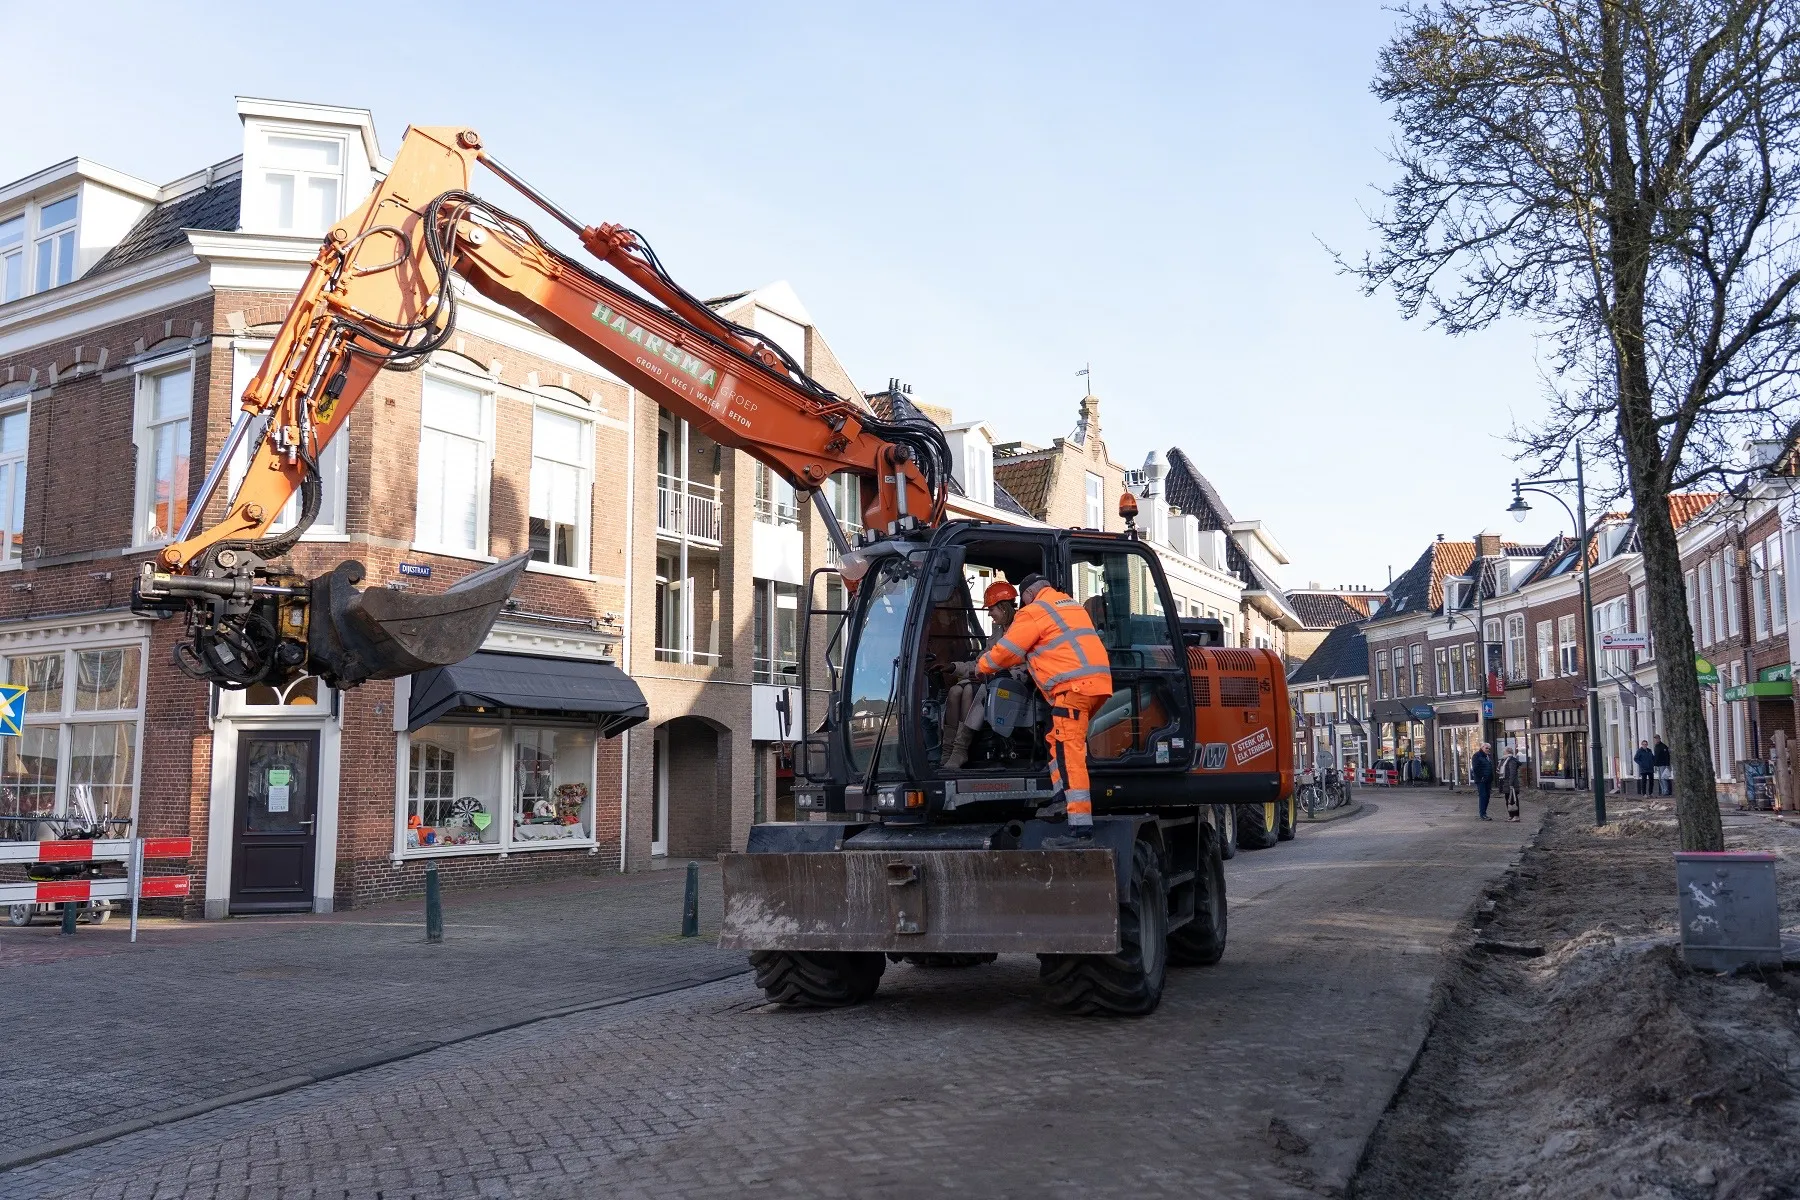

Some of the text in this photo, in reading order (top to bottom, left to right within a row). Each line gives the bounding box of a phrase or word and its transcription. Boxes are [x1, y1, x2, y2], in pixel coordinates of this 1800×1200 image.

[592, 302, 717, 389] HAARSMA
[636, 356, 662, 375] GROND
[671, 377, 688, 391] WEG
[696, 391, 720, 410] WATER
[728, 410, 752, 429] BETON
[720, 386, 759, 413] GROEP
[402, 565, 430, 574] DIJKSTRAAT
[1237, 733, 1265, 752] STERK OP
[1237, 740, 1271, 761] ELK TERREIN
